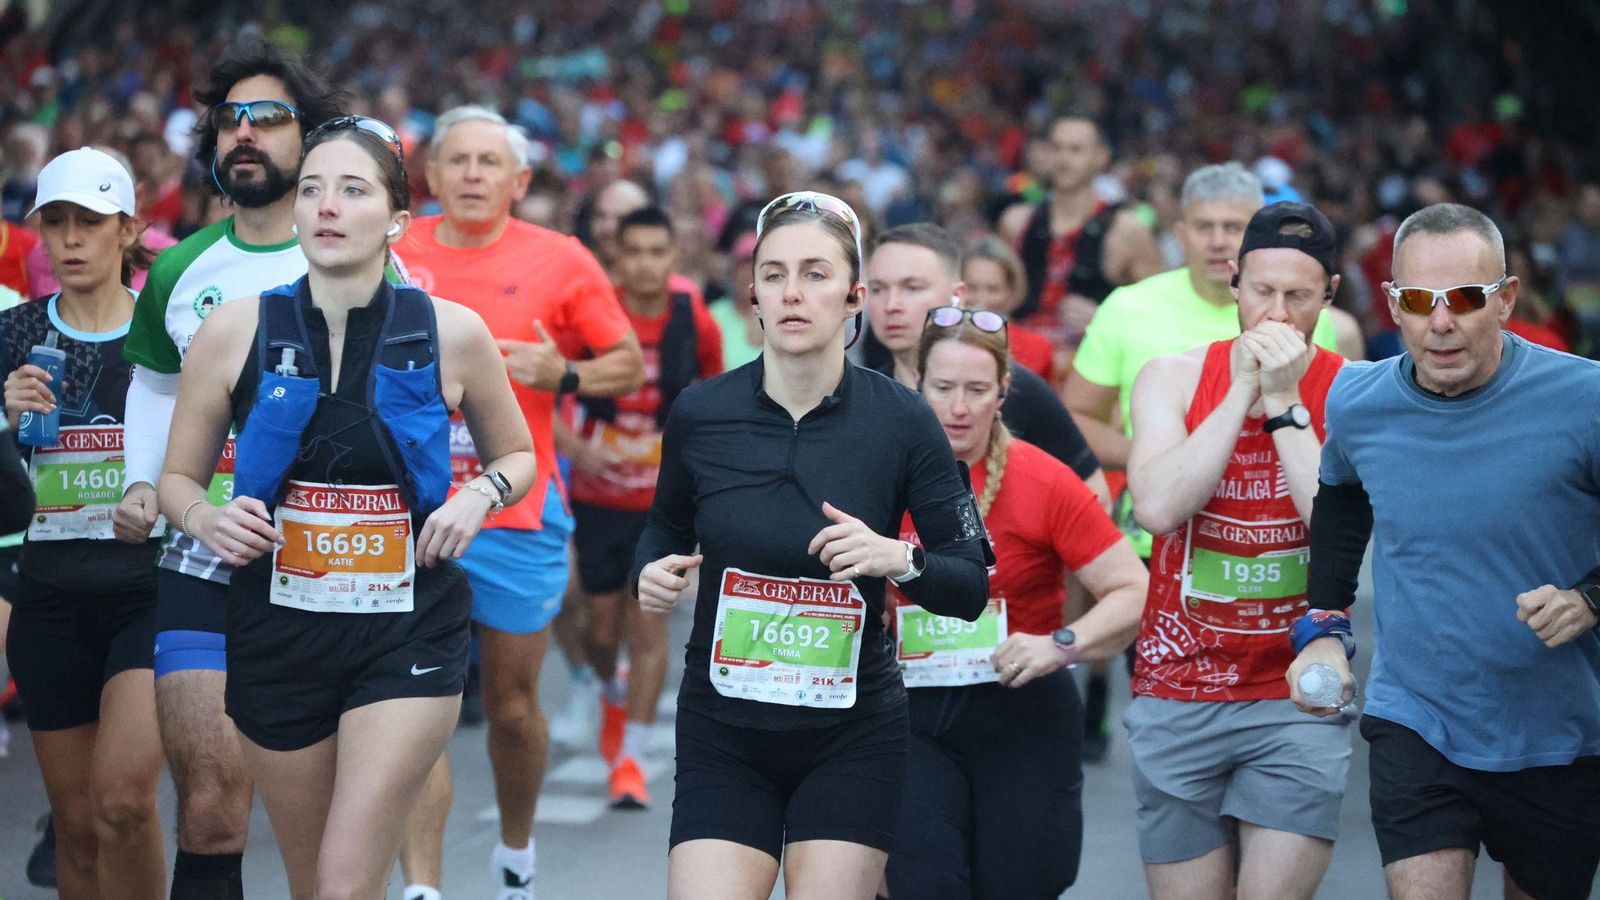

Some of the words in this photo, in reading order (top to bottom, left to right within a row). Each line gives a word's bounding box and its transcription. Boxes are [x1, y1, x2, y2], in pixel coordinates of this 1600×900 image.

[311, 491, 401, 511] GENERALI
[303, 530, 385, 556] 16693
[1222, 525, 1305, 545] GENERALI
[328, 558, 355, 567] KATIE
[1222, 560, 1282, 583] 1935
[367, 583, 392, 592] 21K
[763, 581, 854, 605] GENERALI
[750, 619, 830, 649] 16692
[772, 647, 801, 659] EMMA
[812, 677, 835, 686] 21K
